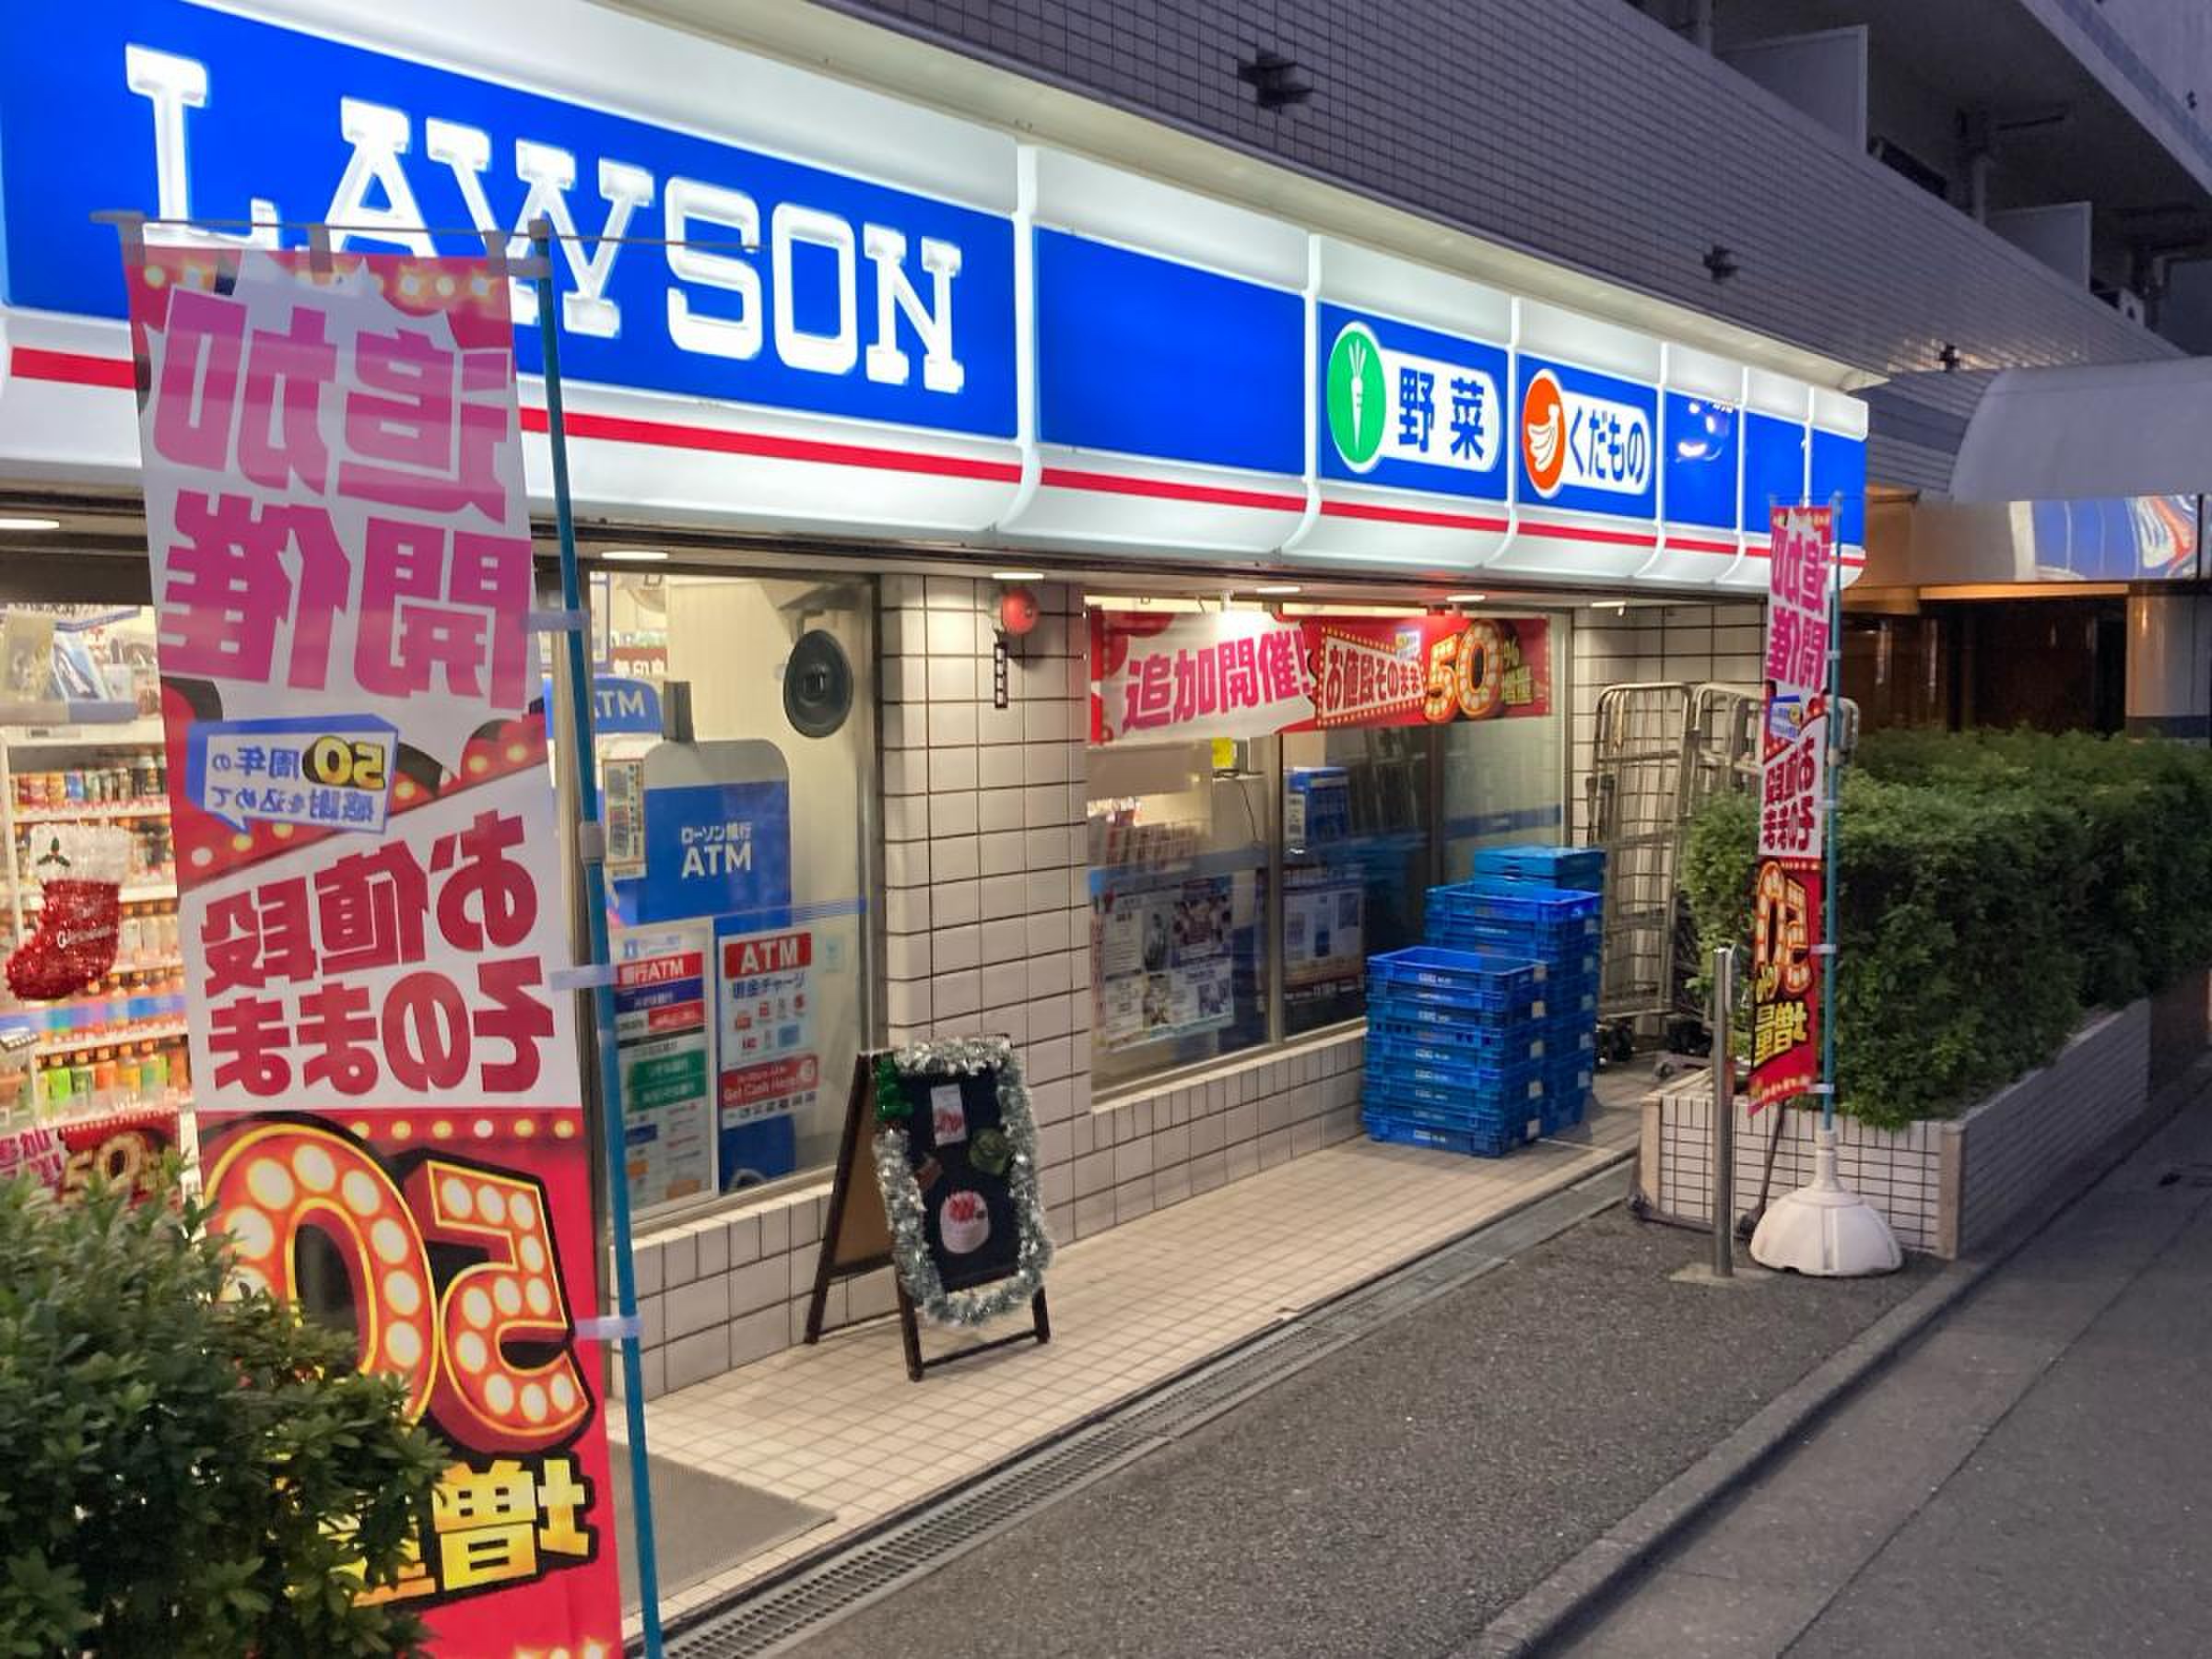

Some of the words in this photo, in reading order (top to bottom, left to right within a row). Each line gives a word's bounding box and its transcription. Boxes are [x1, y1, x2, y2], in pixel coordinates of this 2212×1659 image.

[125, 43, 965, 394] LAWSON
[1399, 367, 1485, 460] 野菜
[1570, 406, 1646, 485] くだもの
[594, 689, 644, 718] TM
[1326, 646, 1421, 711] お値段そのまま
[681, 843, 752, 879] ATM
[740, 937, 798, 974] ATM
